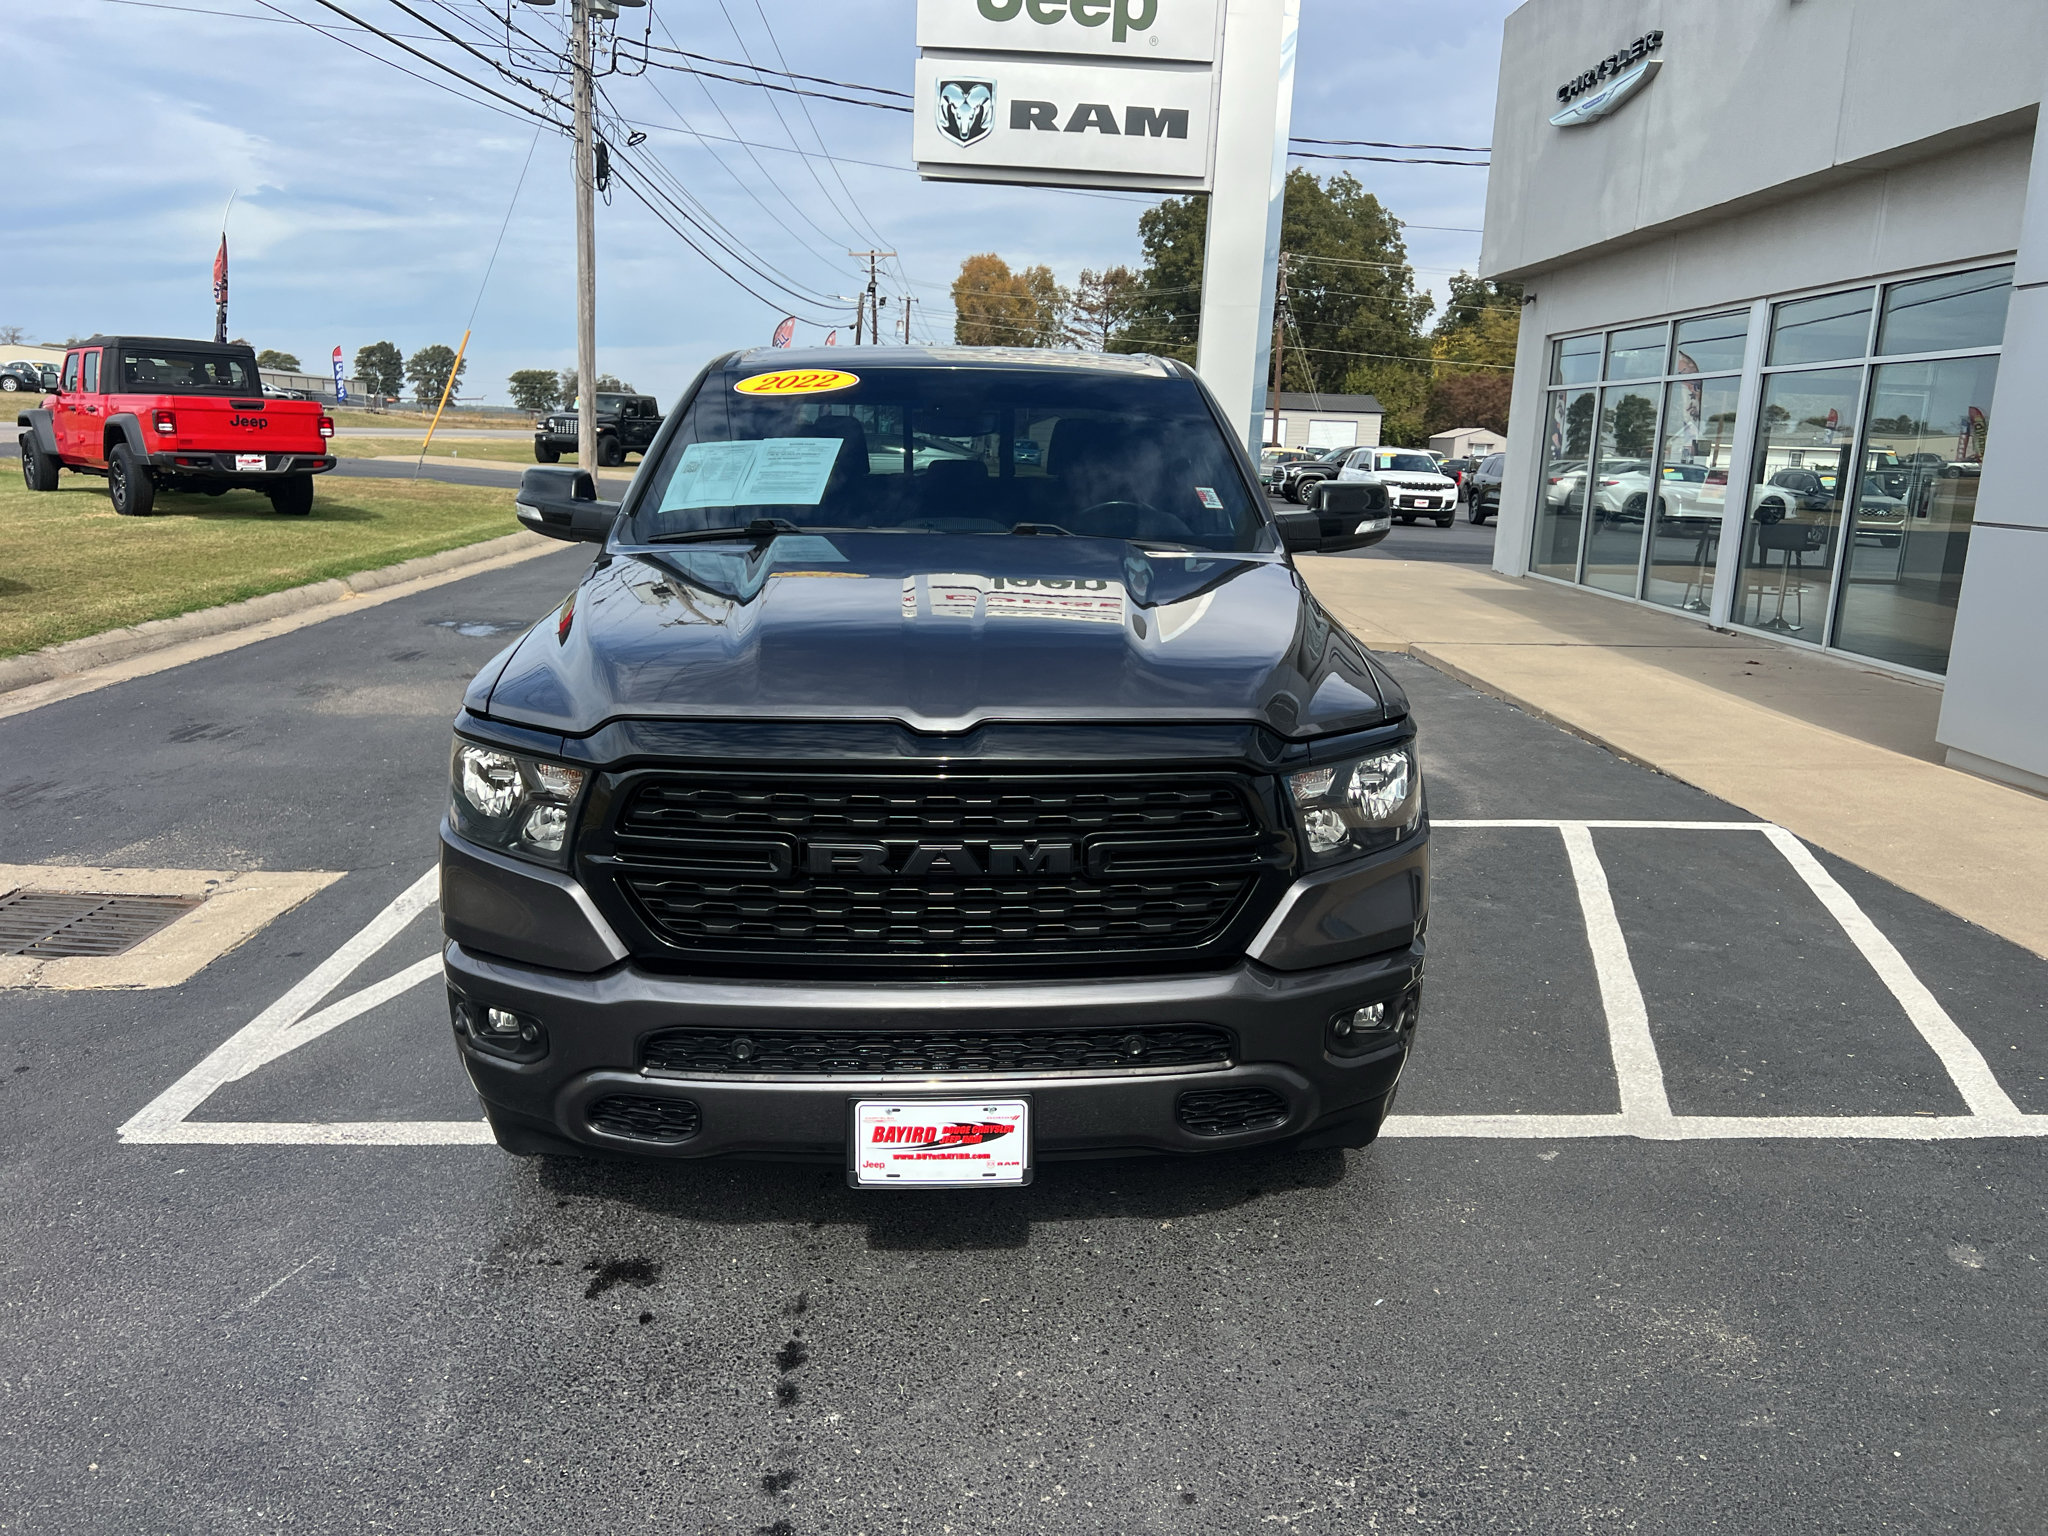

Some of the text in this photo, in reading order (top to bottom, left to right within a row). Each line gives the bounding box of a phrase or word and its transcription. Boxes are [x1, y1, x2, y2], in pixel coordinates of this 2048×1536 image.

[1557, 30, 1664, 102] CHRYSLER
[1009, 100, 1189, 140] RAM
[753, 374, 840, 391] 2022
[229, 415, 268, 429] Jeep
[807, 843, 1072, 874] RAM
[871, 1126, 937, 1143] BAYIRD
[972, 1125, 1015, 1133] CHRYSLER
[938, 1135, 962, 1144] JEEP
[862, 1160, 886, 1169] Jeep
